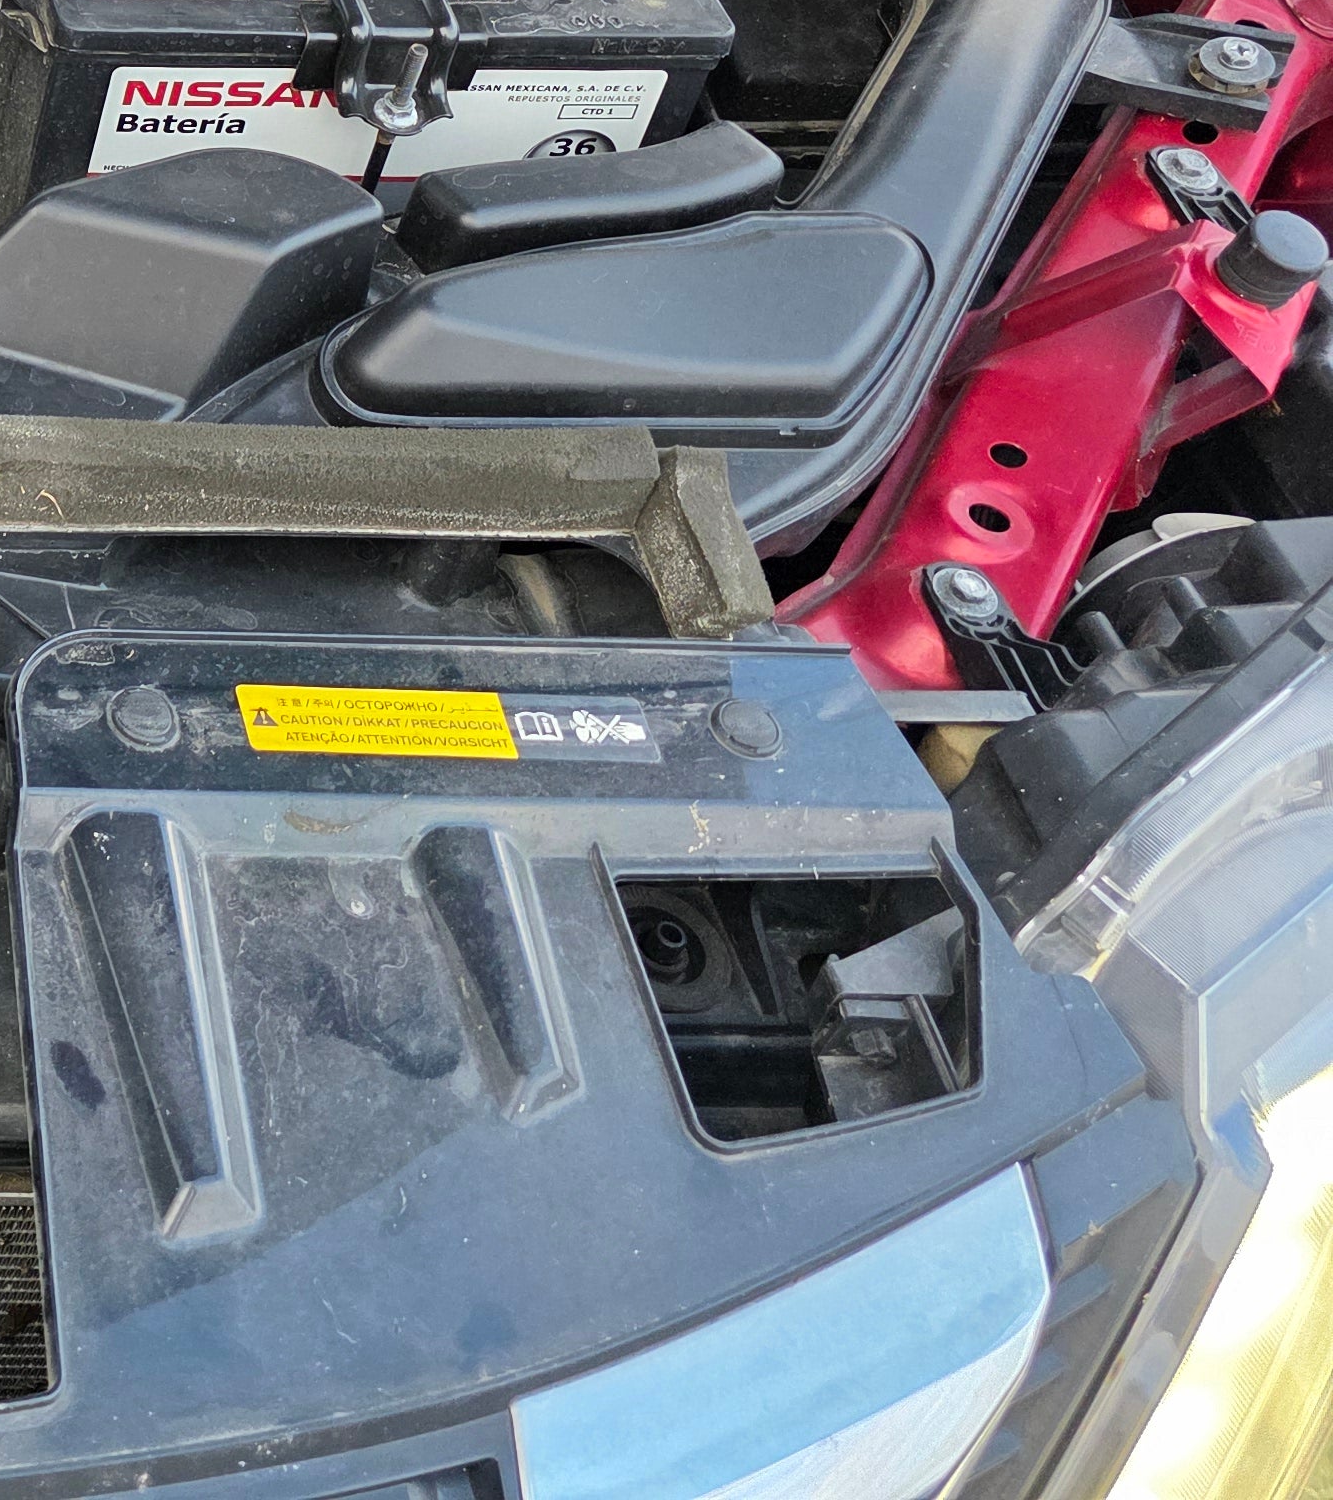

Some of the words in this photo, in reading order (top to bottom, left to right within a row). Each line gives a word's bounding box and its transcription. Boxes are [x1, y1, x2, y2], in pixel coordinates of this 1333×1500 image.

[467, 84, 503, 93] SSAN
[505, 84, 573, 93] MEXICANA,
[576, 84, 600, 93] S.A.
[604, 84, 620, 92] DE
[623, 84, 648, 93] C.V.
[507, 94, 571, 103] REPUESTOS
[573, 95, 642, 103] ORIGINALES
[580, 107, 605, 116] CTD
[606, 107, 614, 116] 1
[115, 113, 247, 134] Batería
[549, 137, 598, 157] 36
[280, 714, 344, 727] CAUTION
